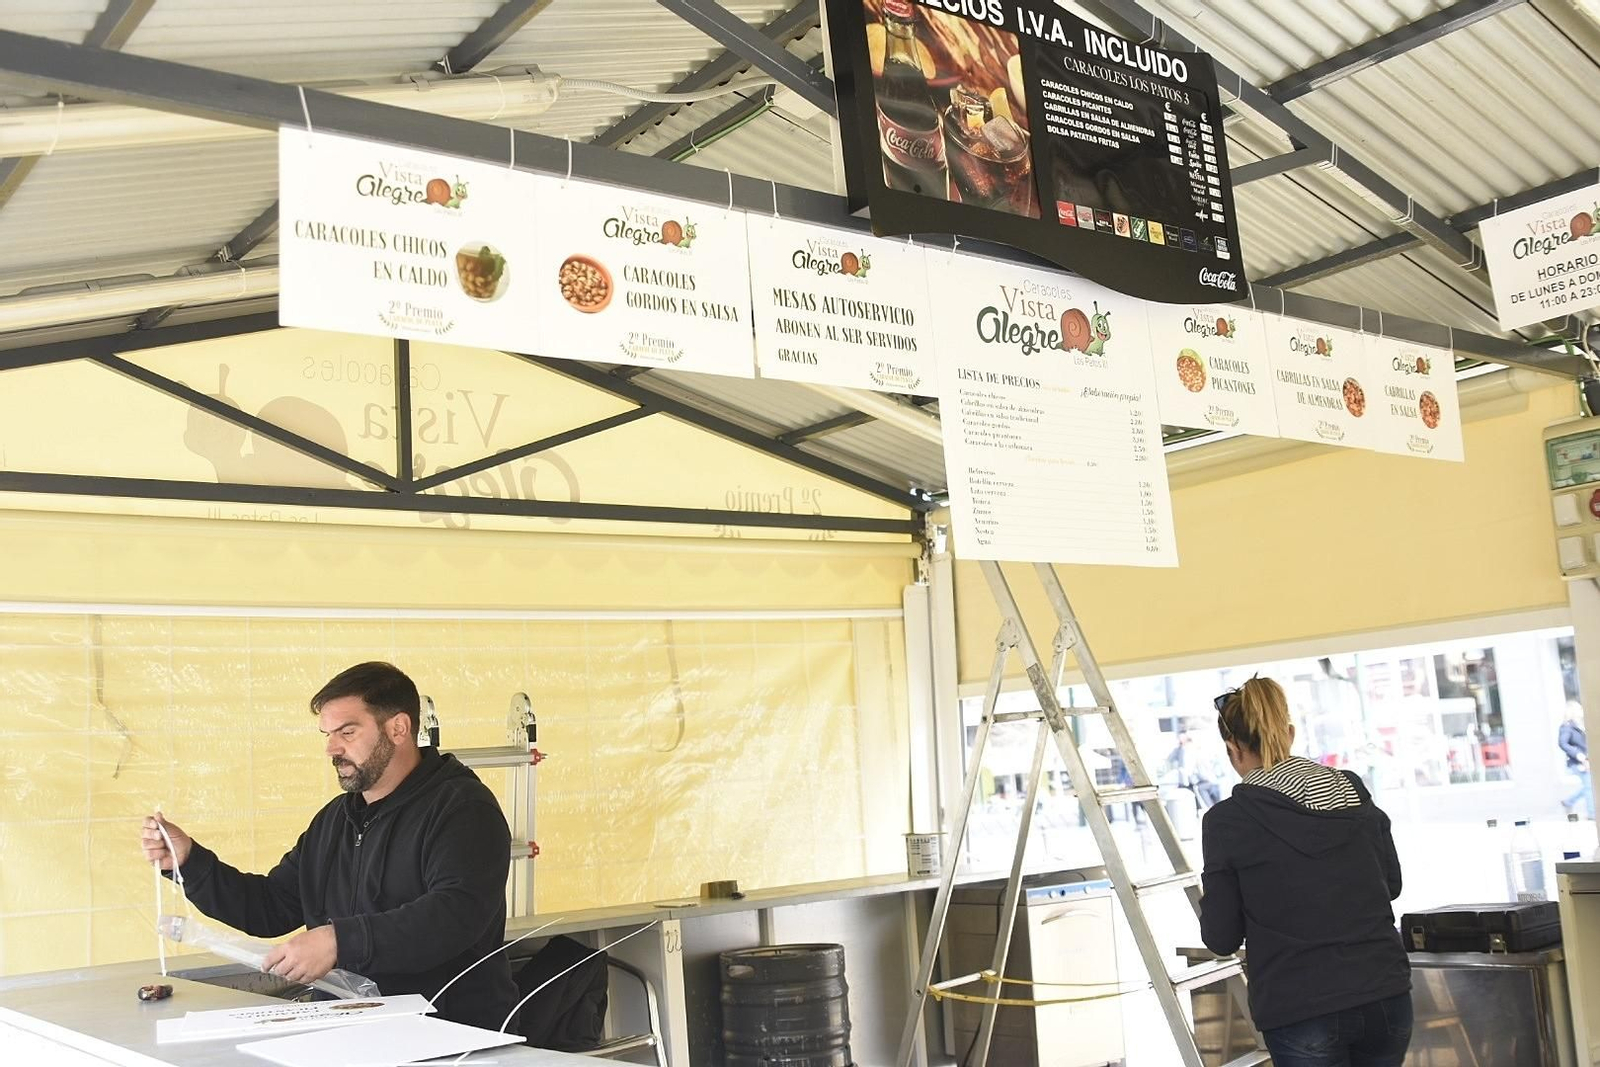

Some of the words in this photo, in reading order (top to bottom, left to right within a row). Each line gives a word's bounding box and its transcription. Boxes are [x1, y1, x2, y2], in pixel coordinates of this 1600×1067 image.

[1016, 7, 1073, 48] I.V.A.
[1084, 28, 1188, 83] INCLUIDO
[1063, 56, 1128, 87] CARACOLES
[1130, 75, 1149, 93] LOS
[1151, 82, 1183, 104] PATOS
[1184, 92, 1190, 105] 3
[1041, 79, 1079, 95] CARACOLES
[1080, 89, 1104, 102] CHICOS
[1104, 95, 1113, 104] EN
[1114, 98, 1134, 110] CALDO
[1042, 91, 1081, 106] CARACOLES
[1082, 101, 1112, 115] PICANTES
[1044, 102, 1080, 117] CABRILLAS
[1081, 110, 1089, 120] EN
[1091, 112, 1110, 125] SALSA
[1111, 118, 1119, 128] DE
[1120, 121, 1156, 137] ALMENDRAS
[1045, 113, 1084, 129] CARACOLES
[1085, 123, 1111, 136] GORDOS
[1112, 129, 1120, 138] EN
[1121, 131, 1141, 144] SALSA
[1047, 125, 1069, 137] BOLSA
[1070, 131, 1097, 144] PATATAS
[1098, 138, 1120, 149] FRITAS
[379, 161, 423, 186] Vista
[356, 174, 424, 205] Alegre
[622, 205, 659, 227] Vista
[1526, 218, 1568, 236] Vista
[295, 220, 387, 249] CARACOLES
[393, 234, 447, 258] CHICOS
[603, 217, 660, 246] Alegre
[806, 239, 839, 259] Vista
[1513, 232, 1570, 259] Alegre
[373, 261, 392, 280] EN
[399, 265, 448, 287] CALDO
[792, 249, 840, 276] Alegre
[1537, 253, 1598, 280] HORARIO
[623, 264, 696, 291] CARACOLES
[1023, 279, 1072, 301] Caracoles
[1199, 267, 1237, 291] Coca-Cola
[999, 285, 1057, 322] Vista
[1511, 291, 1526, 304] DE
[1528, 280, 1566, 299] LUNES
[1569, 278, 1577, 288] A
[1540, 294, 1567, 309] 11:00
[1570, 291, 1578, 302] A
[405, 302, 444, 320] Premio
[626, 291, 677, 314] GORDOS
[682, 299, 697, 317] EN
[701, 301, 738, 322] SALSA
[772, 287, 817, 311] MESAS
[822, 296, 915, 326] AUTOSERVICIO
[642, 332, 675, 349] Premio
[775, 318, 821, 339] ABONEN
[825, 325, 839, 341] AL
[842, 327, 863, 345] SER
[866, 330, 918, 352] SERVIDOS
[976, 306, 1060, 356] Alegre
[778, 348, 818, 365] GRACIAS
[1209, 356, 1250, 374] CARACOLES
[887, 363, 913, 377] Premio
[958, 368, 983, 383] LISTA
[986, 372, 999, 384] DE
[1002, 374, 1041, 389] PRECIOS
[1276, 369, 1311, 387] CABRILLAS
[1312, 376, 1321, 388] EN
[1321, 377, 1341, 391] SALSA
[1211, 377, 1256, 395] PICANTONES
[1384, 385, 1416, 400] CABRILLAS
[1297, 391, 1306, 404] DE
[1308, 393, 1343, 410] ALMENDRAS
[1390, 403, 1399, 415] EN
[1399, 405, 1417, 418] SALSA
